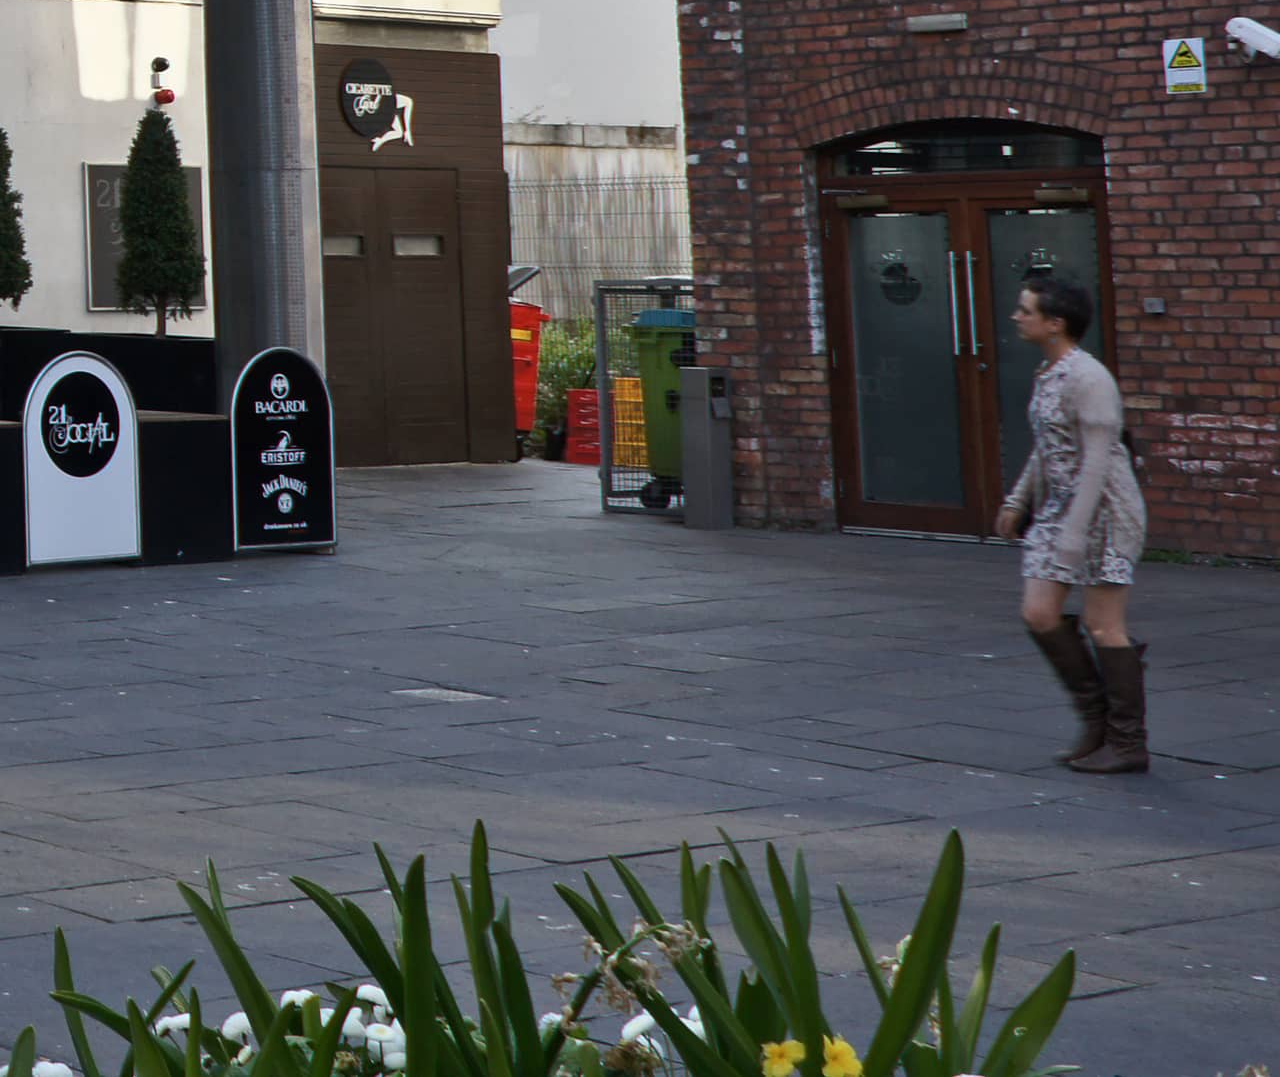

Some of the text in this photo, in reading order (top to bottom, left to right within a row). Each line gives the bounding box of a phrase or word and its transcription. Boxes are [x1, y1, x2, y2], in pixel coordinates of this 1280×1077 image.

[345, 83, 392, 96] CIGARETTE
[95, 179, 122, 209] 21
[49, 404, 67, 424] 21
[255, 399, 309, 414] BACARDI
[50, 412, 115, 454] SOCIAL
[261, 451, 305, 464] ERISTOFF
